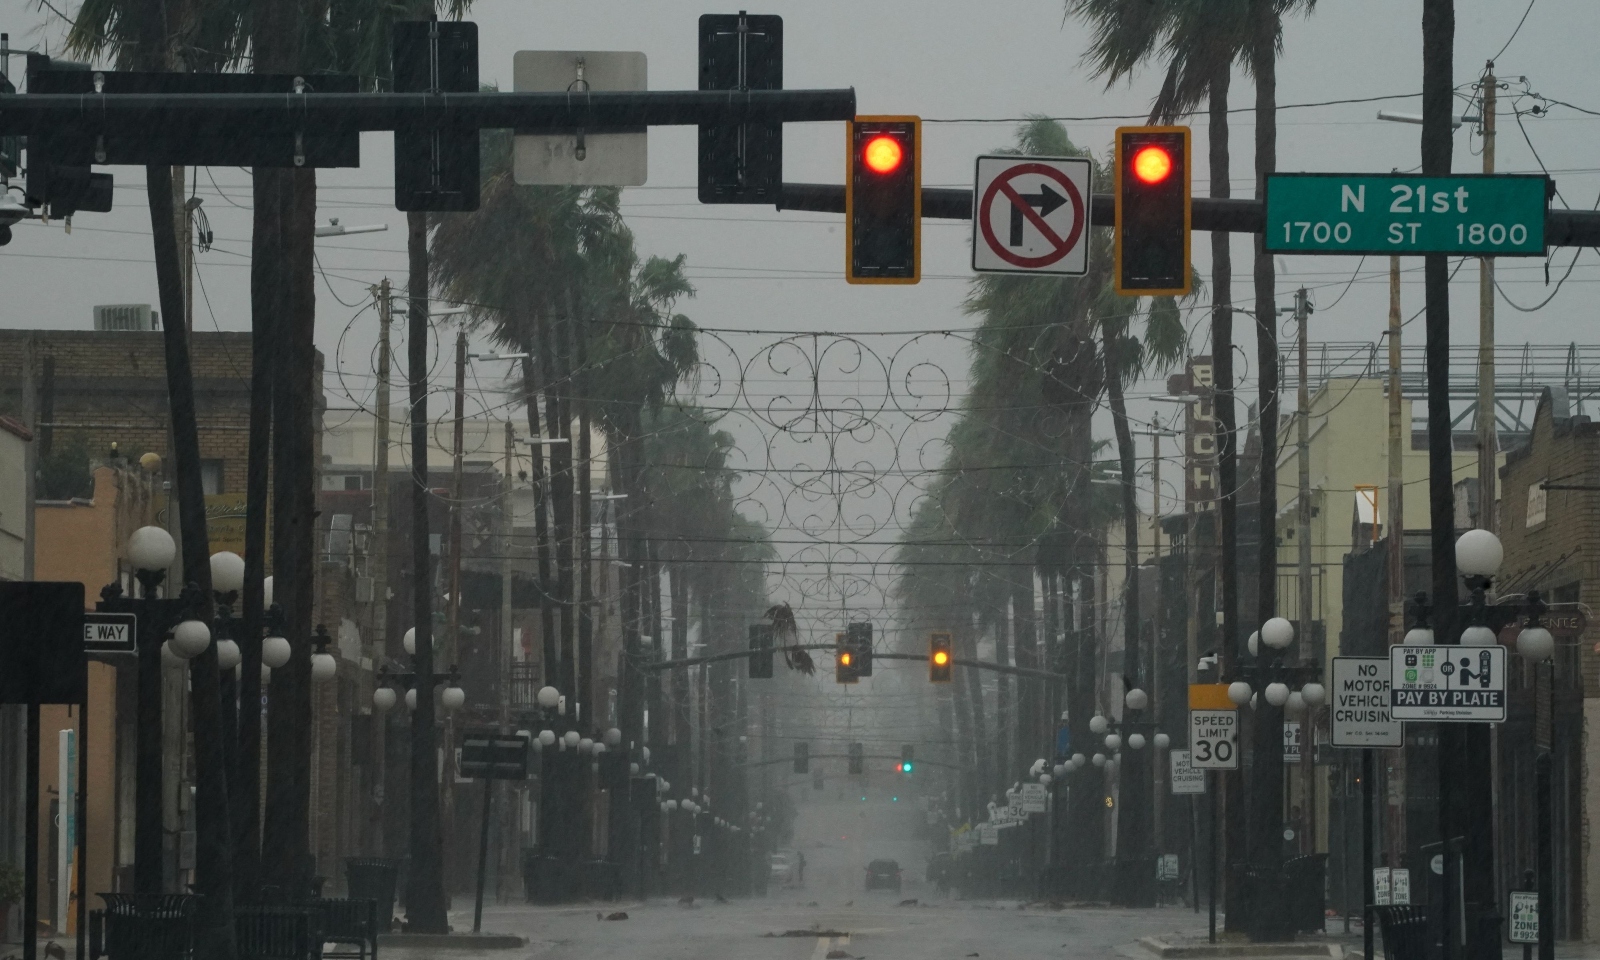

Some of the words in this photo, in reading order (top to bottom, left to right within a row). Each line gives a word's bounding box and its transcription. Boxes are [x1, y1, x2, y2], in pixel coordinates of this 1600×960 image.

[1341, 184, 1365, 213] N
[1389, 184, 1469, 213] 21st
[1283, 221, 1352, 244] 1700
[1387, 222, 1421, 245] ST
[1456, 223, 1528, 246] 1800
[97, 625, 125, 640] WAY
[1358, 664, 1378, 677] NO
[1442, 665, 1453, 673] OR
[1339, 695, 1389, 707] VEHICL
[1397, 691, 1423, 705] PAY
[1429, 691, 1447, 705] BY
[1452, 691, 1498, 706] PLATE
[1194, 716, 1234, 726] SPEED
[1335, 710, 1396, 723] CRUISIN
[1198, 728, 1229, 738] LIMIT
[1195, 740, 1232, 762] 30
[1514, 921, 1538, 930] ZONE
